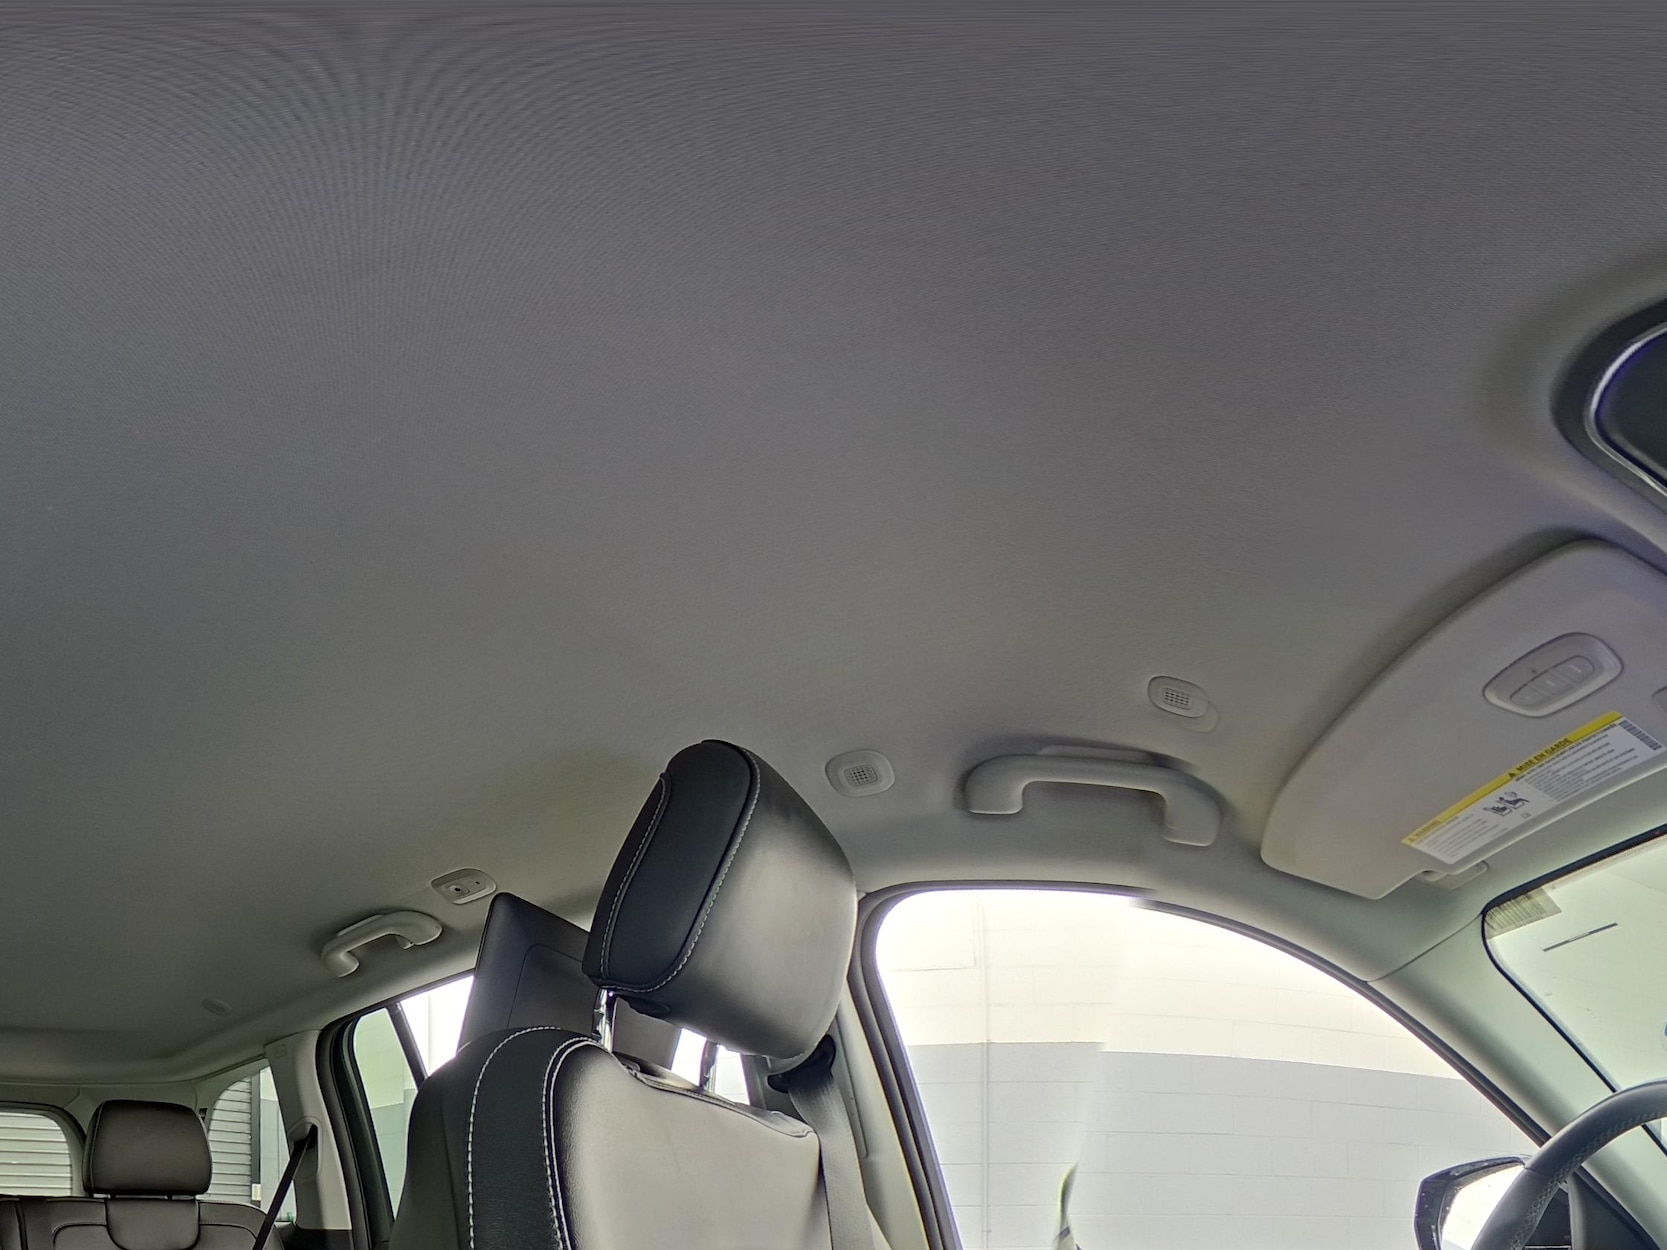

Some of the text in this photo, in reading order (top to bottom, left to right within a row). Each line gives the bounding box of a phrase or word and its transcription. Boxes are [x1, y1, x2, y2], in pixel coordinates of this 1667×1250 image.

[1516, 738, 1572, 772] MISE EN GARDE
